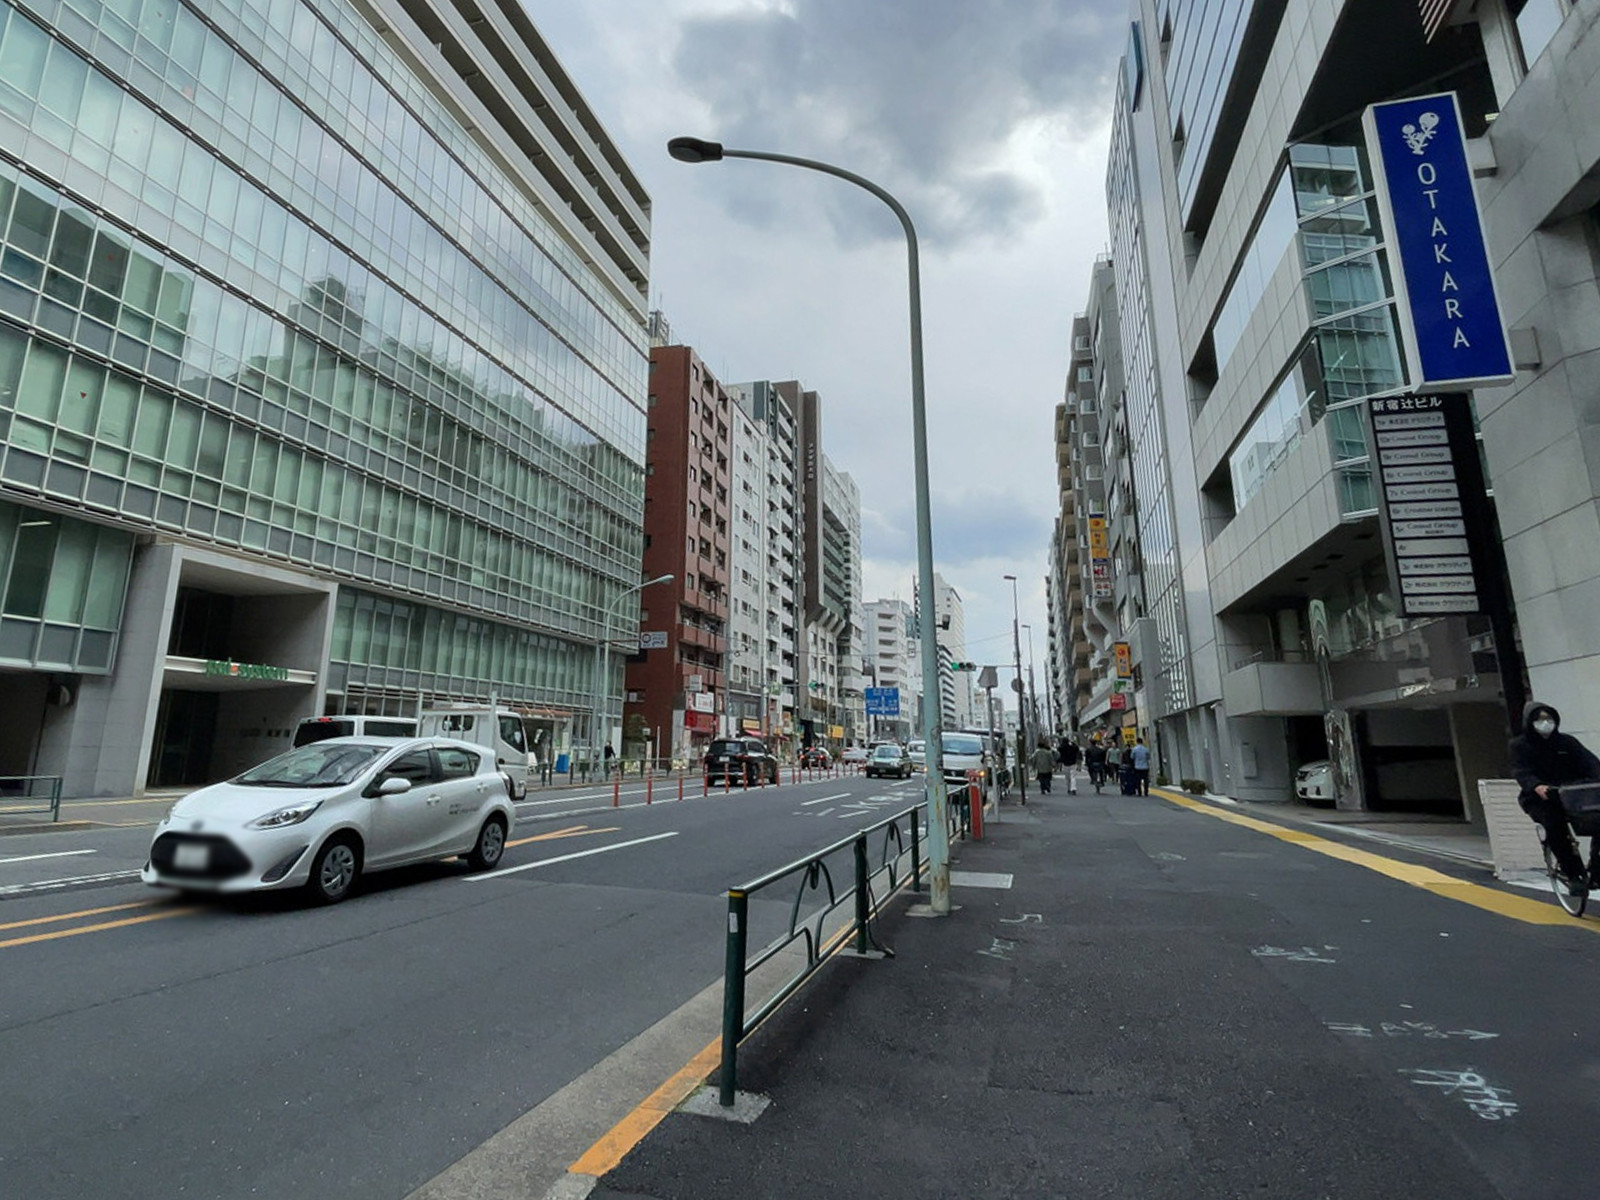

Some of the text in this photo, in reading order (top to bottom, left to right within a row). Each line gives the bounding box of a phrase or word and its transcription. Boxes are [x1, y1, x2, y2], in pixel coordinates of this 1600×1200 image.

[1417, 162, 1470, 349] OTAKARA
[1372, 396, 1442, 412] 新宿辻ビル
